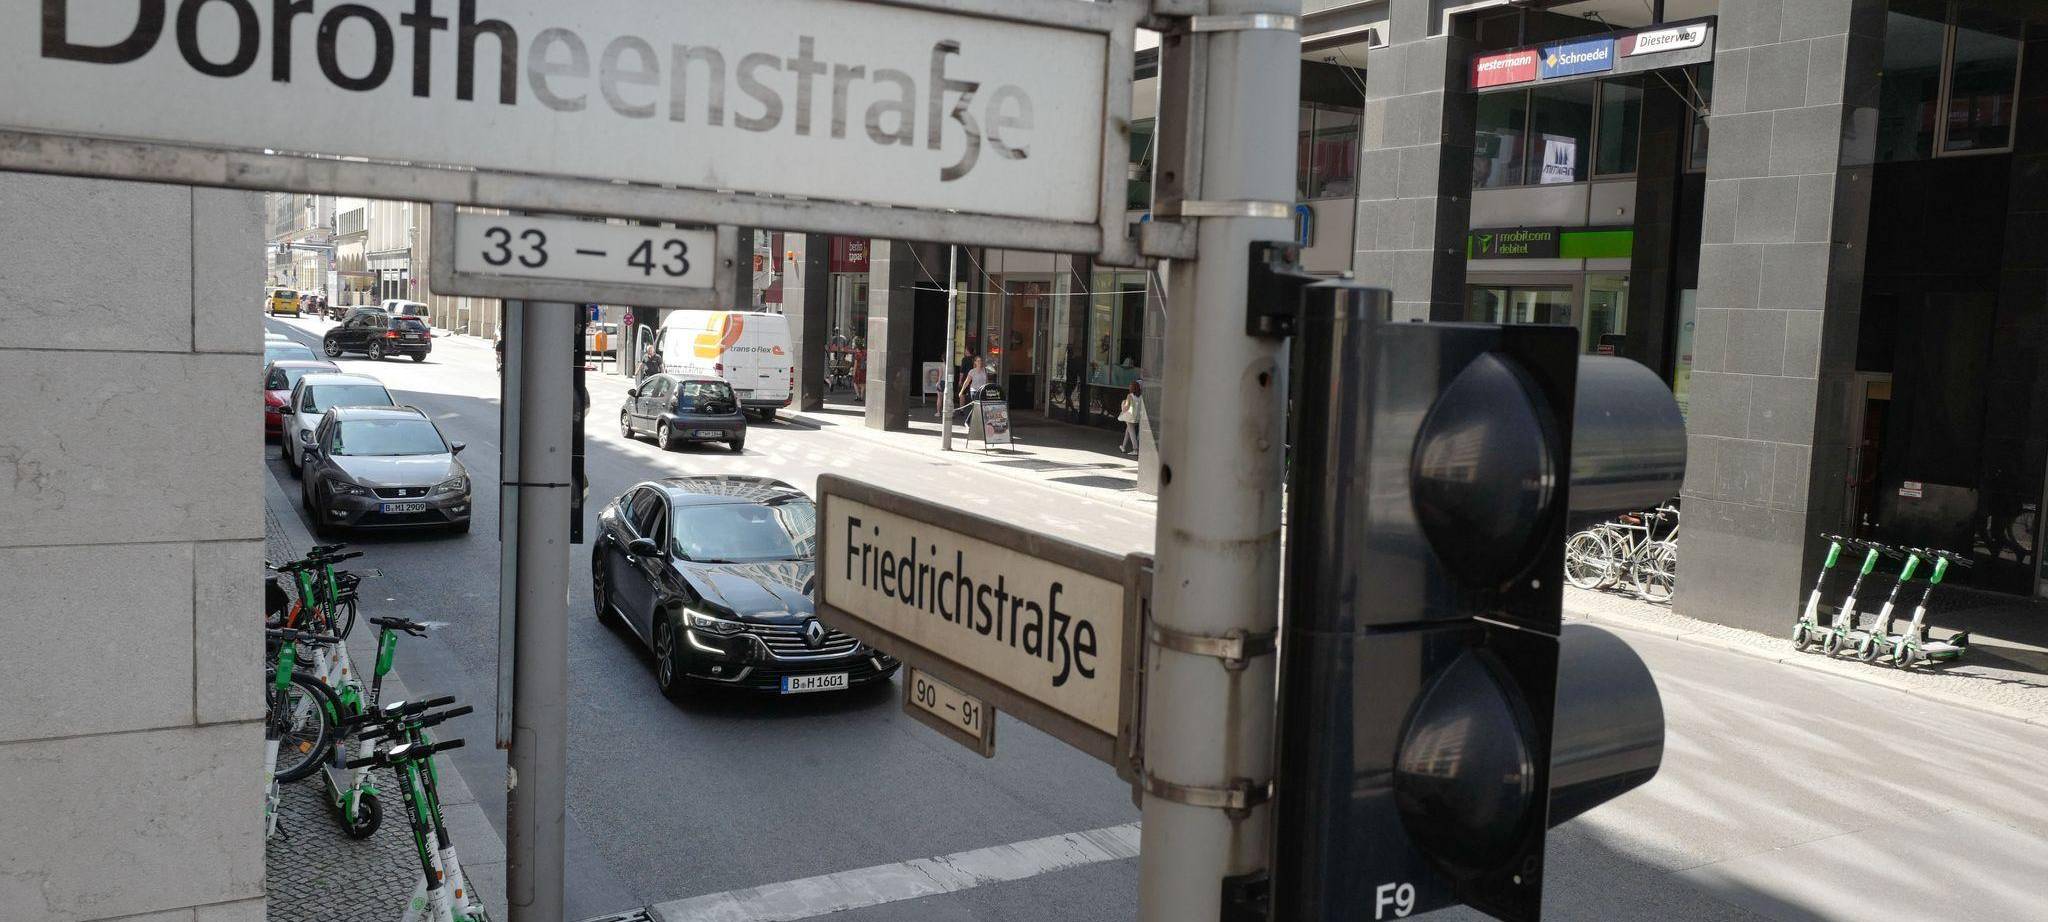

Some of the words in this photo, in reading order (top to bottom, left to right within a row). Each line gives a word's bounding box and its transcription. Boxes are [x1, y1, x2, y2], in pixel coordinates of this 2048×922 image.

[1559, 47, 1608, 65] Schroedel
[1639, 30, 1697, 48] Diesterweg
[1477, 54, 1532, 72] westermann
[42, 0, 1034, 182] Dorotheenstraße
[482, 226, 548, 268] 33
[627, 239, 690, 277] 43
[1500, 243, 1529, 254] debitel
[846, 515, 1097, 687] Friedrichstraße
[917, 679, 937, 708] 90
[962, 702, 980, 729] 91
[1374, 882, 1416, 920] F9
